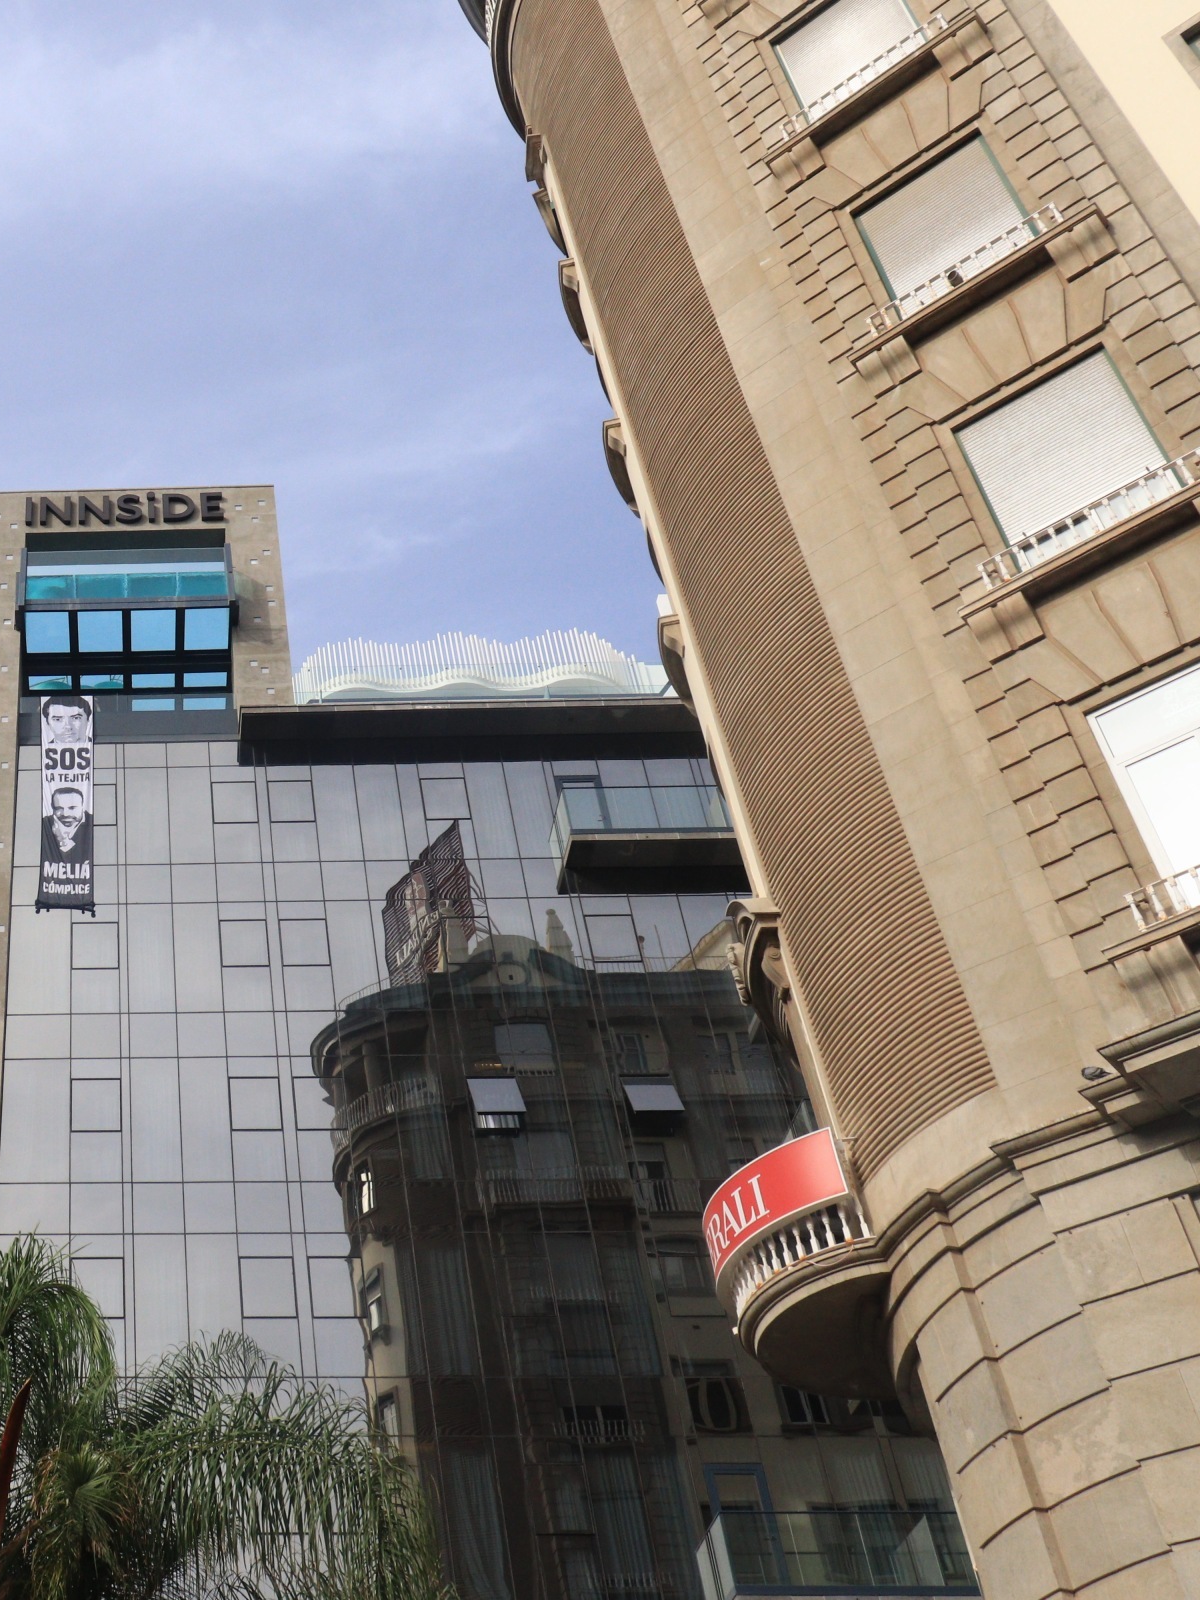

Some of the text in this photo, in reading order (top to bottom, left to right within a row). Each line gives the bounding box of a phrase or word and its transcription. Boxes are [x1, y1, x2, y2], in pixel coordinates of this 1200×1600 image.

[44, 747, 91, 771] SOS
[45, 772, 91, 783] LA TEJITA
[43, 860, 90, 880] MELIÁ
[42, 880, 90, 895] CÓMPLICE
